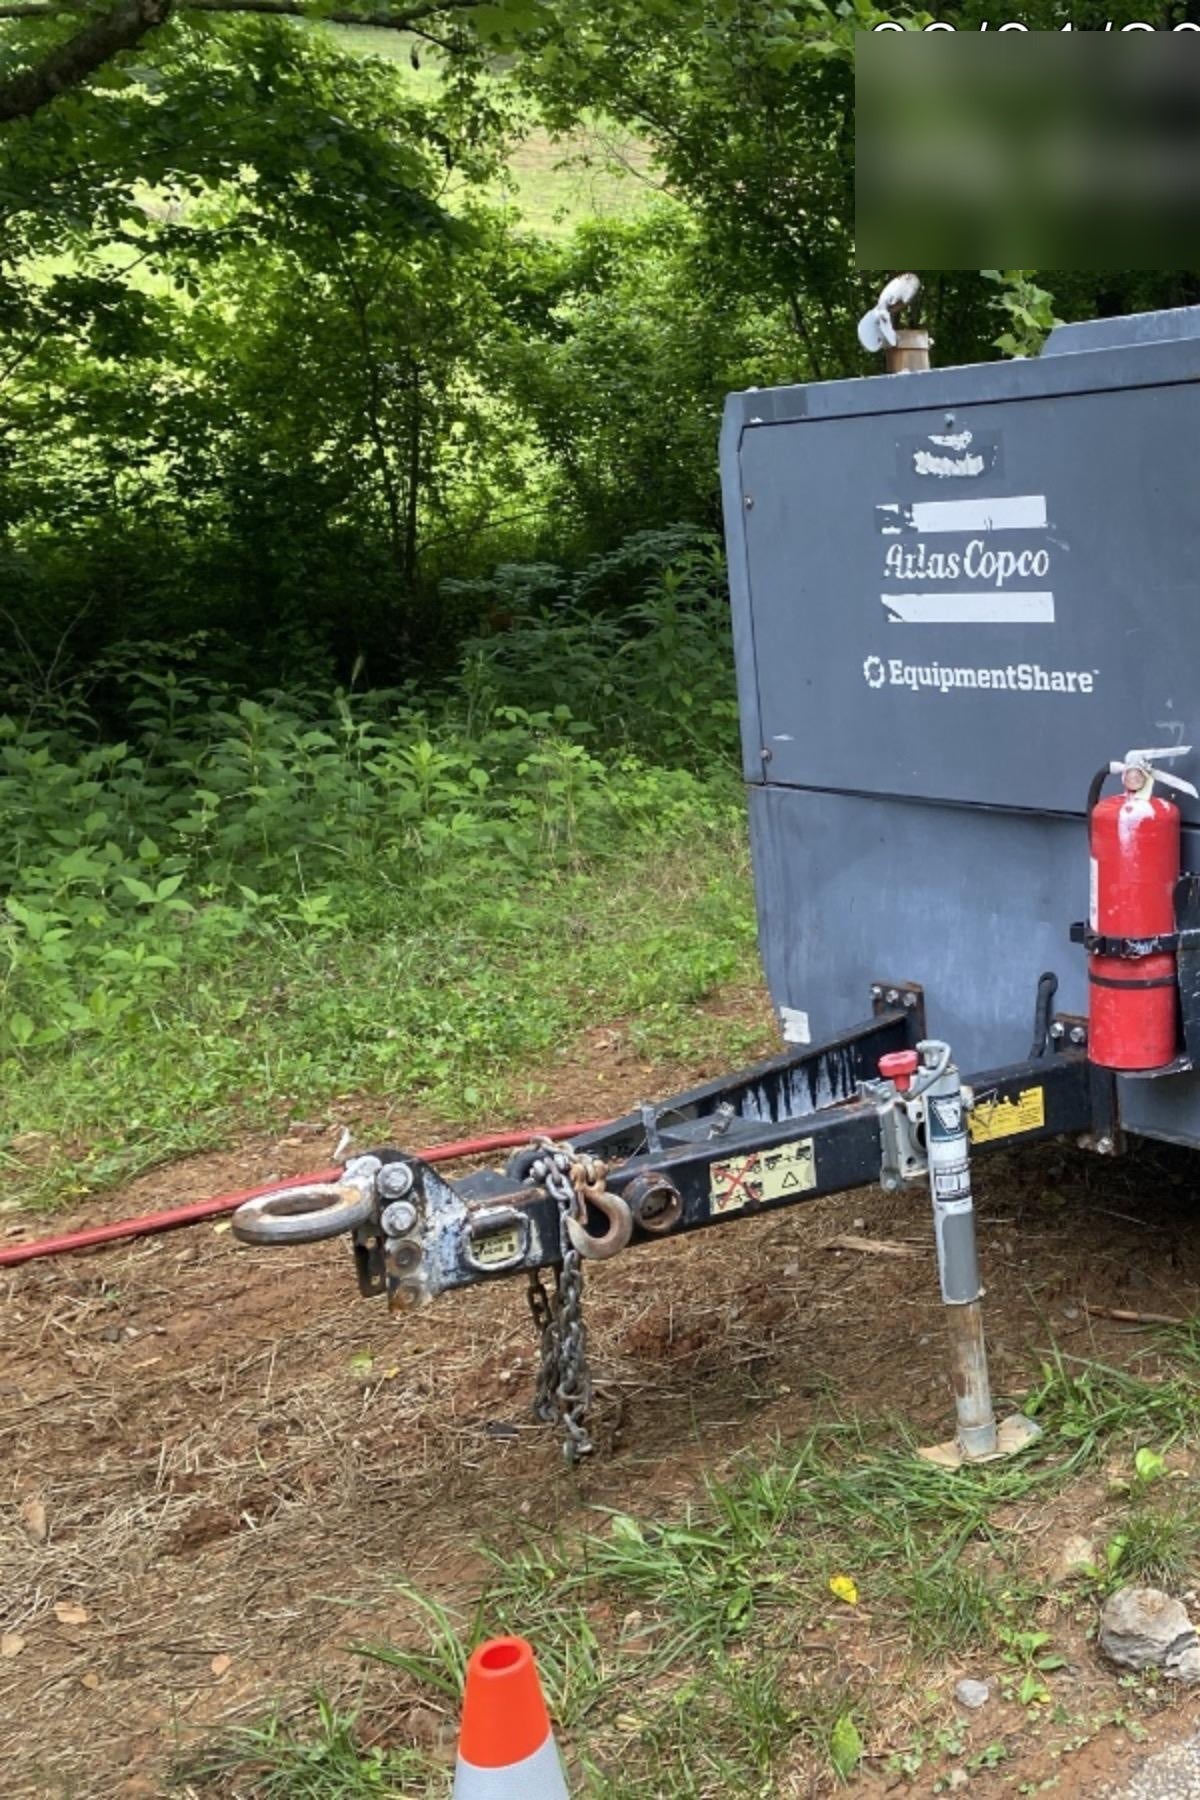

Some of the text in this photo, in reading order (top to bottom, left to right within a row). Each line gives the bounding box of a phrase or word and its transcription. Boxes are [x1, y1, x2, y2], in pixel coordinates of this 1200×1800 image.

[883, 539, 1050, 587] Atlas Copco
[887, 657, 1094, 693] EquipmentShare
